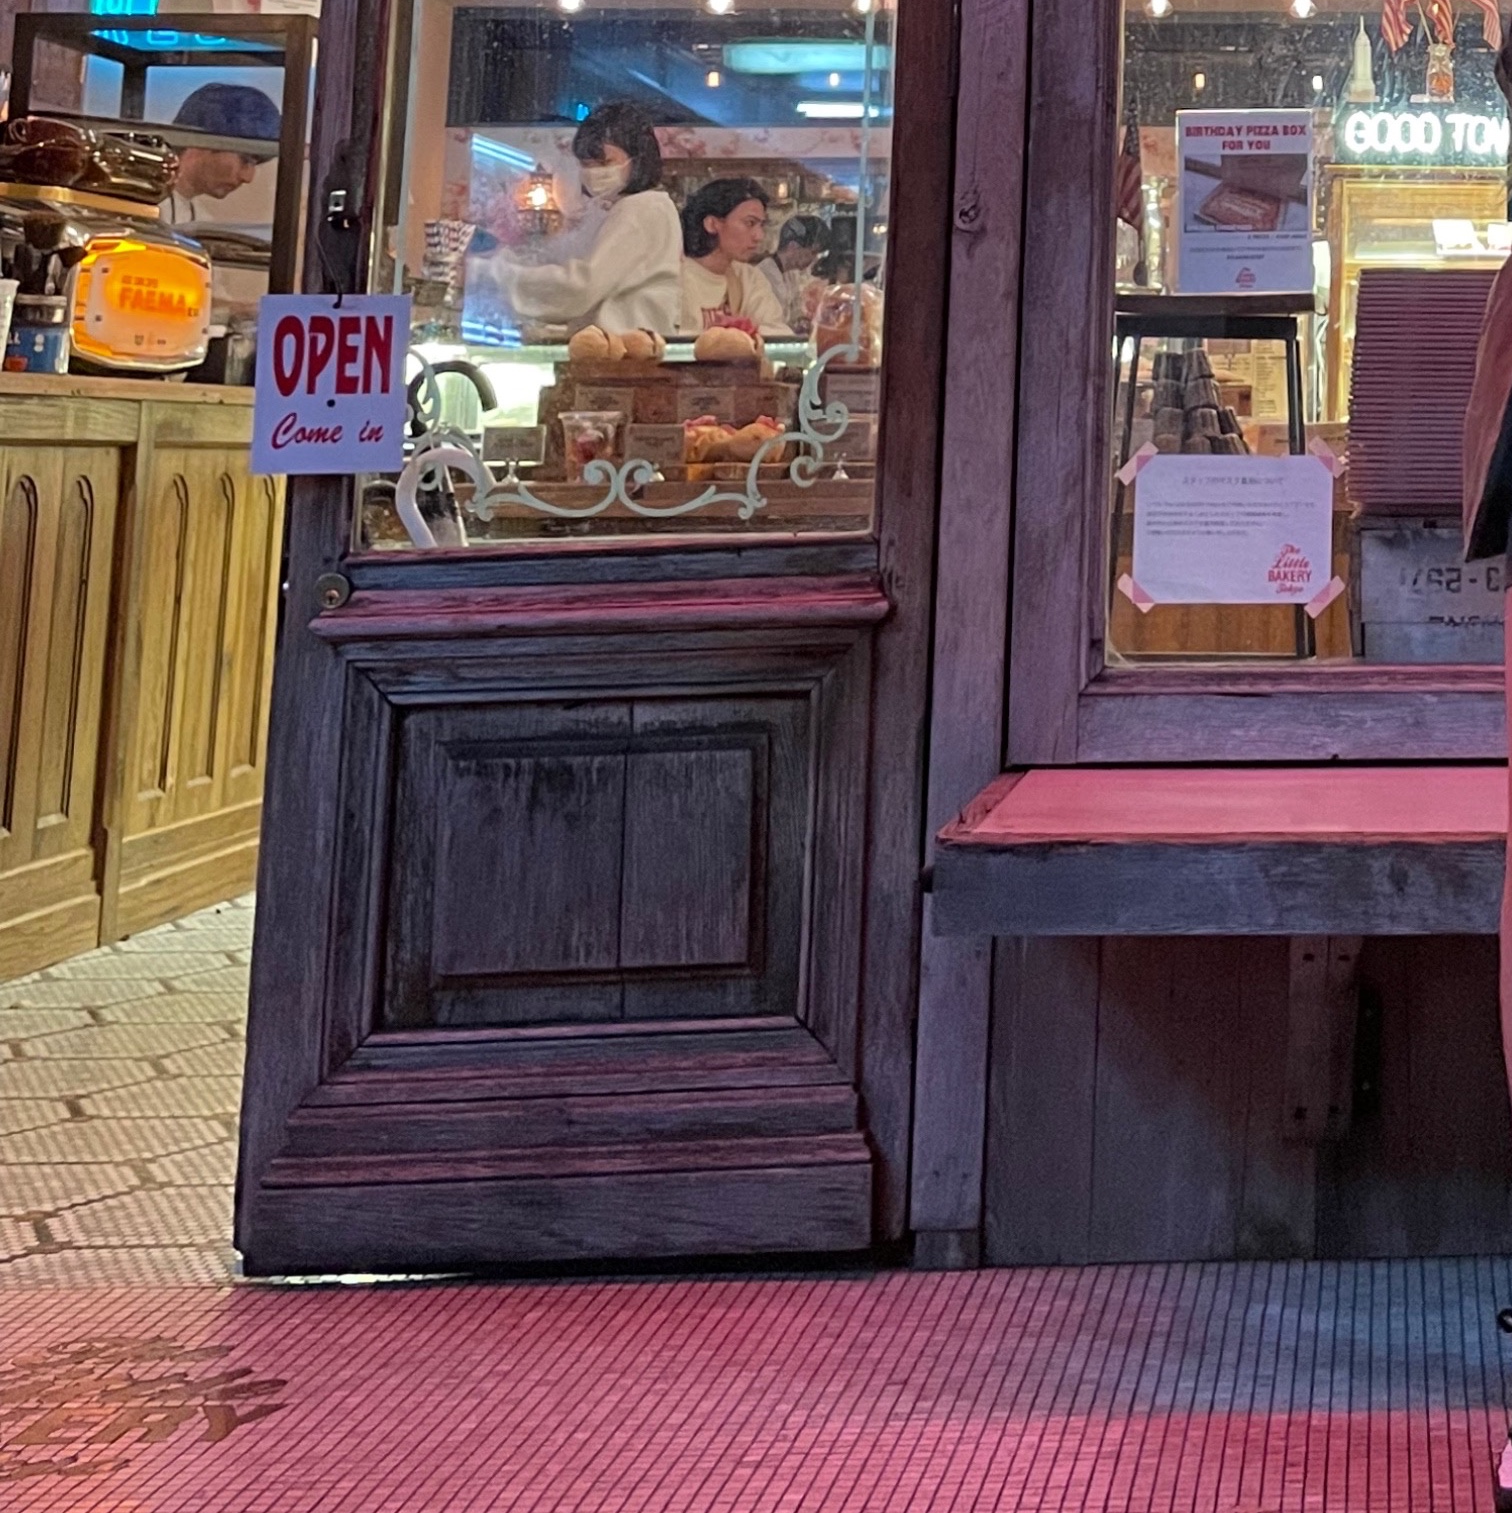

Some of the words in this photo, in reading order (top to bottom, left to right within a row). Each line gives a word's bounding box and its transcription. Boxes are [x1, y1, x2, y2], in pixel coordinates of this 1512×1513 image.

[1185, 125, 1243, 137] BIRTHDAY
[1246, 125, 1279, 136] PIZZA
[1282, 124, 1307, 136] BOX
[1345, 111, 1442, 154] GOOD
[1221, 140, 1244, 151] FOR
[1247, 140, 1271, 150] YOU
[273, 315, 394, 397] OPEN
[271, 412, 345, 449] Come
[358, 418, 385, 444] in
[1268, 569, 1313, 583] BAKERY
